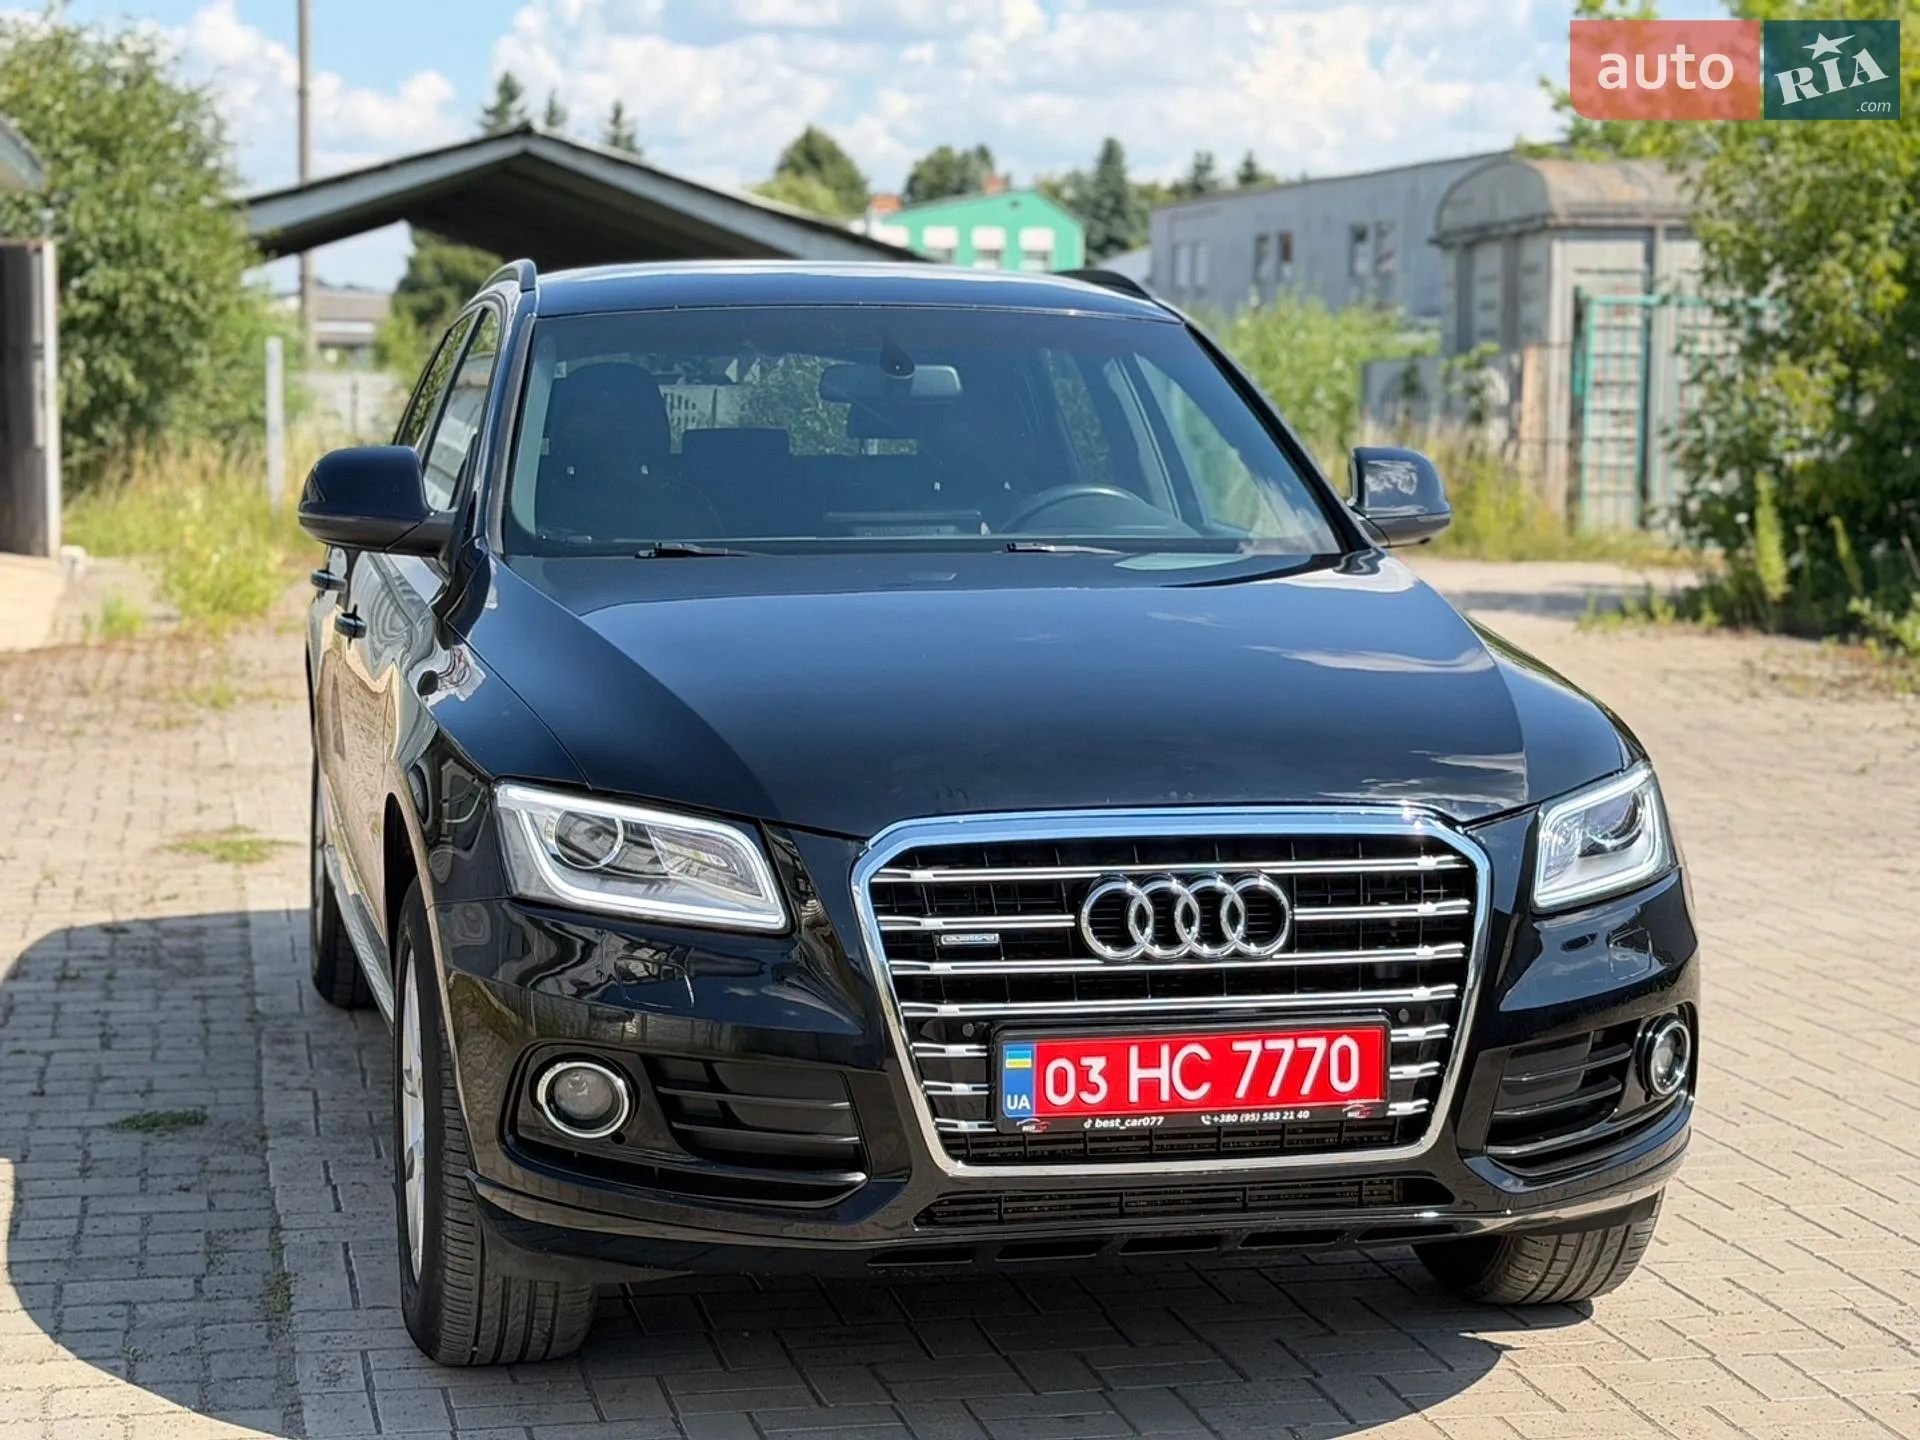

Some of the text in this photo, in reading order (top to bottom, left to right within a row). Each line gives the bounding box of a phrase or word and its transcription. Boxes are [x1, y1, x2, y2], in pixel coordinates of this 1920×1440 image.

[1044, 1035, 1360, 1107] 03 HC 7770
[1006, 1094, 1031, 1110] UA
[1095, 1116, 1165, 1130] best_car077
[1212, 1113, 1238, 1124] +380
[1297, 1110, 1310, 1119] 40
